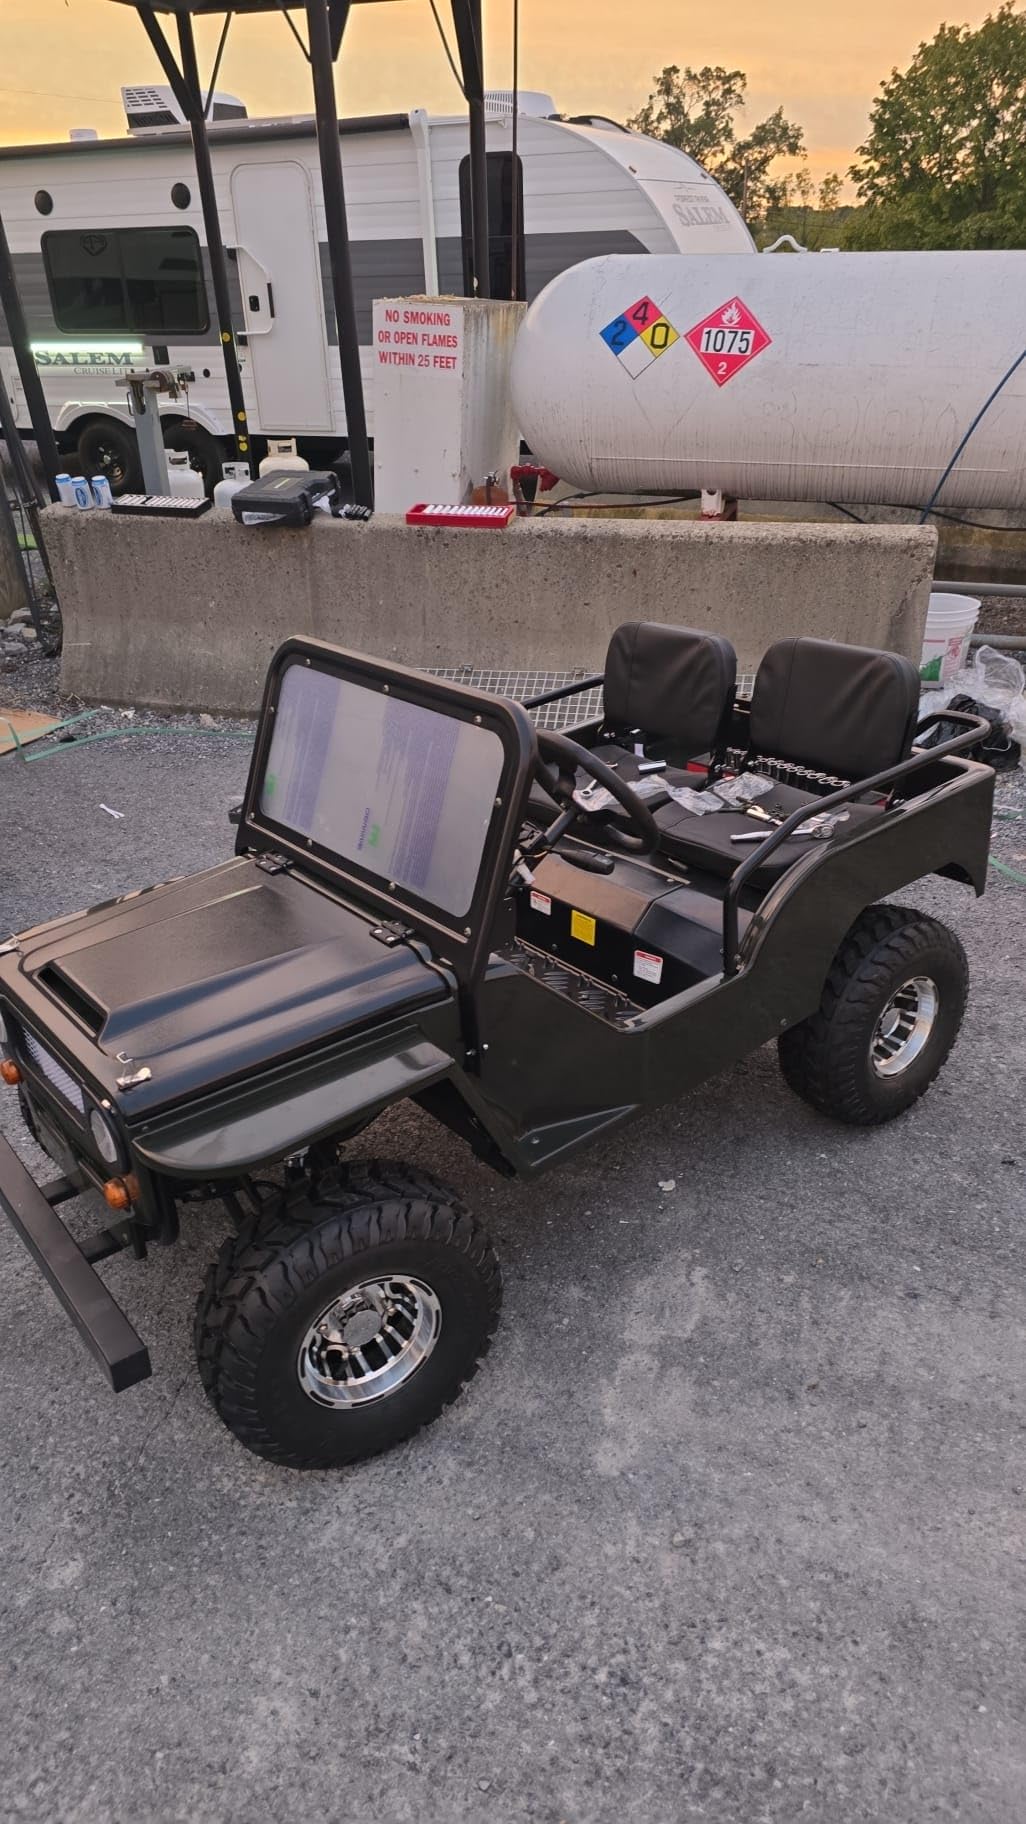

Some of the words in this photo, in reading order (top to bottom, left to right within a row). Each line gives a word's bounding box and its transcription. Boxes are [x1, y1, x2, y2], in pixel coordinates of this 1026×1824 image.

[672, 203, 730, 227] SALEM
[385, 309, 400, 323] NO
[403, 310, 451, 326] SMOKING
[632, 301, 650, 326] 4
[378, 330, 391, 344] OR
[393, 331, 418, 346] OPEN
[421, 333, 458, 348] FLAMES
[611, 319, 627, 346] 2
[650, 322, 670, 350] 0
[704, 329, 752, 354] 1075
[34, 350, 134, 366] SALEM
[379, 351, 415, 366] WITHIN
[417, 354, 430, 368] 25
[433, 355, 457, 370] FEET
[73, 367, 111, 376] CRUISE
[111, 367, 129, 376] LIT
[717, 361, 727, 375] 2
